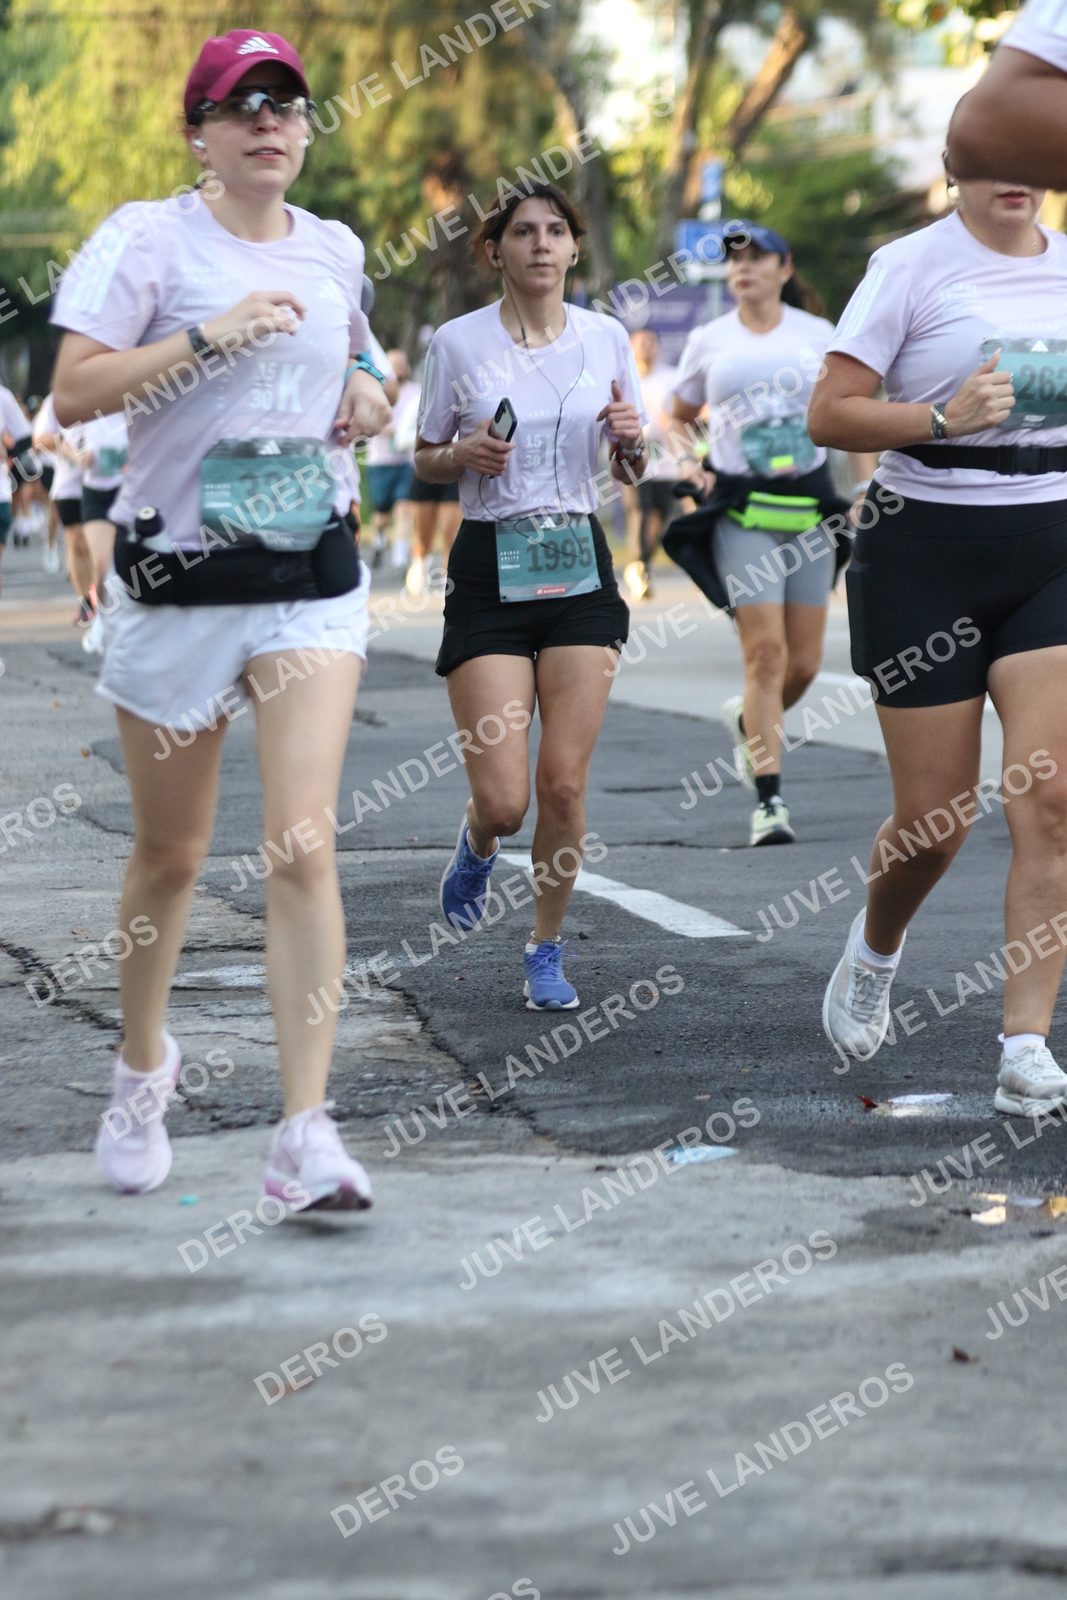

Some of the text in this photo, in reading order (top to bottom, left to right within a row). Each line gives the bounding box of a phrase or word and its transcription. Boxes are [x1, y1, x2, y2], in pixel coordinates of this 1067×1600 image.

[277, 363, 309, 414] K
[525, 434, 542, 449] 15
[523, 453, 541, 468] 30
[526, 537, 593, 573] 1995
